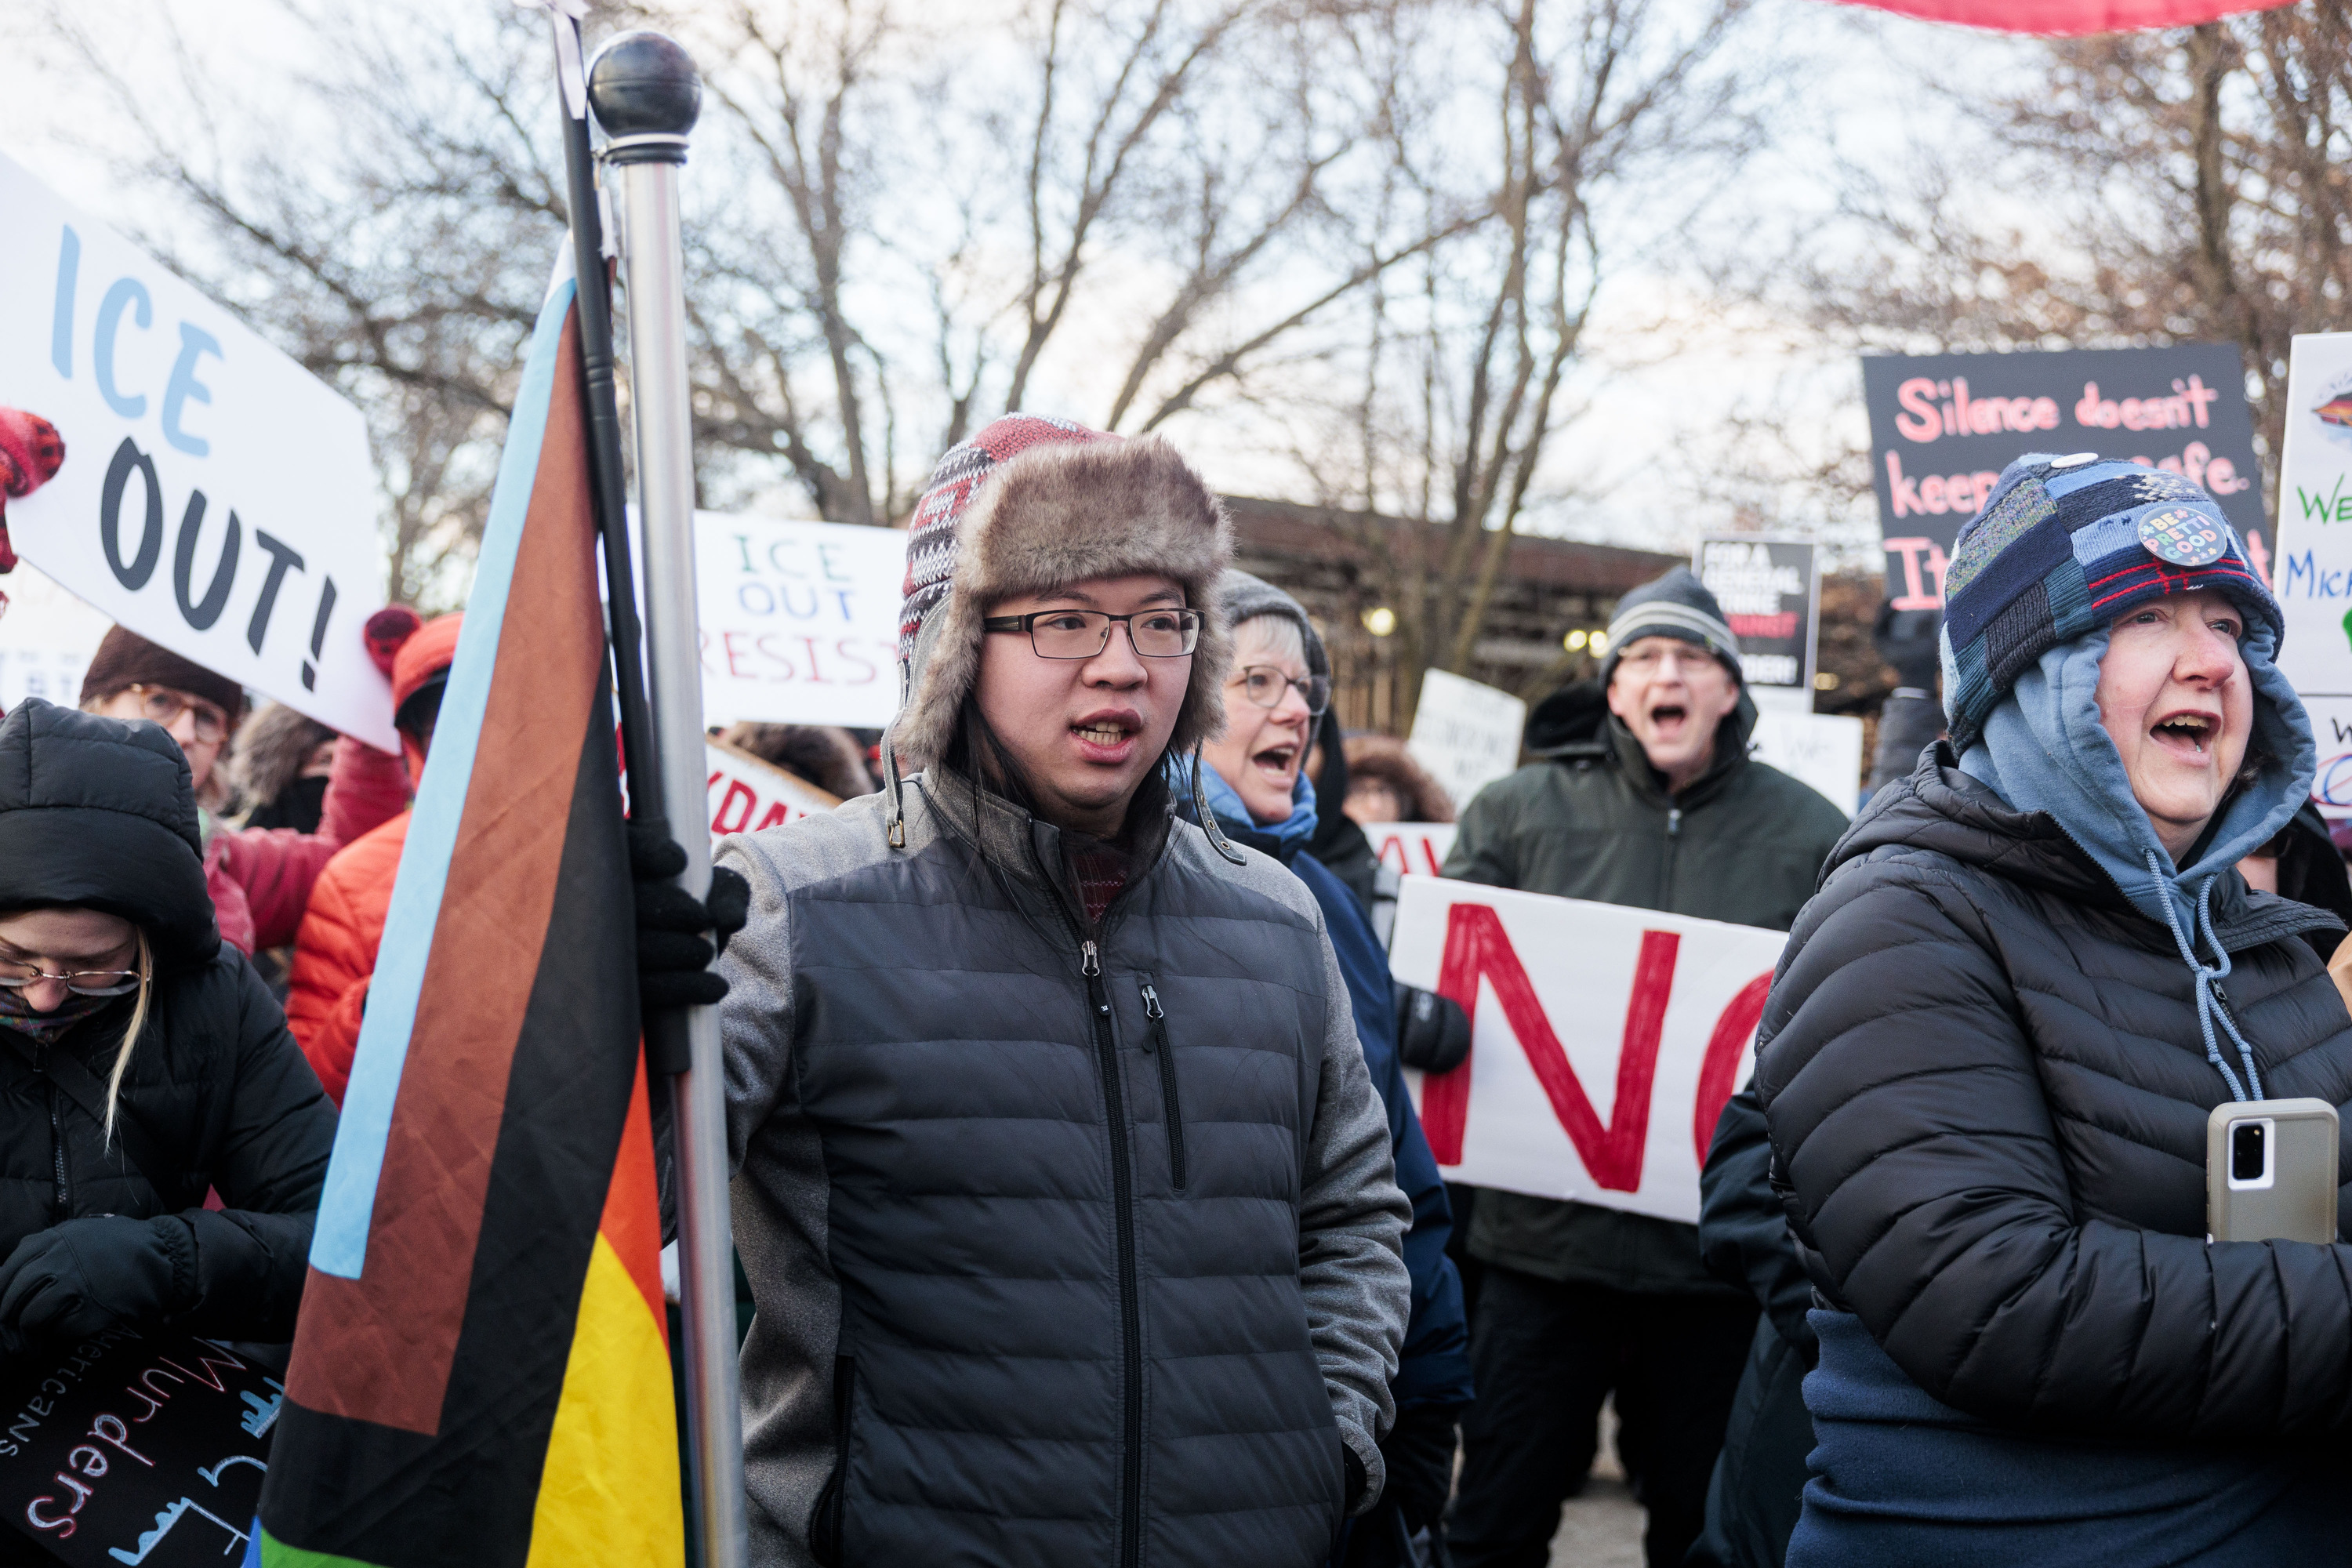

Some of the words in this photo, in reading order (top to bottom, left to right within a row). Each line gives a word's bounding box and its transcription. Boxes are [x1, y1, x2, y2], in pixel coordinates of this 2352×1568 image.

[52, 223, 224, 457] ICE
[1896, 376, 2060, 443] Silence
[2075, 374, 2218, 430] doesn't
[2130, 441, 2250, 495] fe.
[2143, 515, 2210, 552] PRETTI
[2150, 513, 2180, 531] BE
[2165, 529, 2217, 559] GOOD
[101, 436, 336, 692] OUT!
[733, 534, 853, 582] ICE
[739, 582, 856, 622] OUT
[1716, 592, 1780, 615] TRIKE
[27, 1336, 248, 1540] Murders
